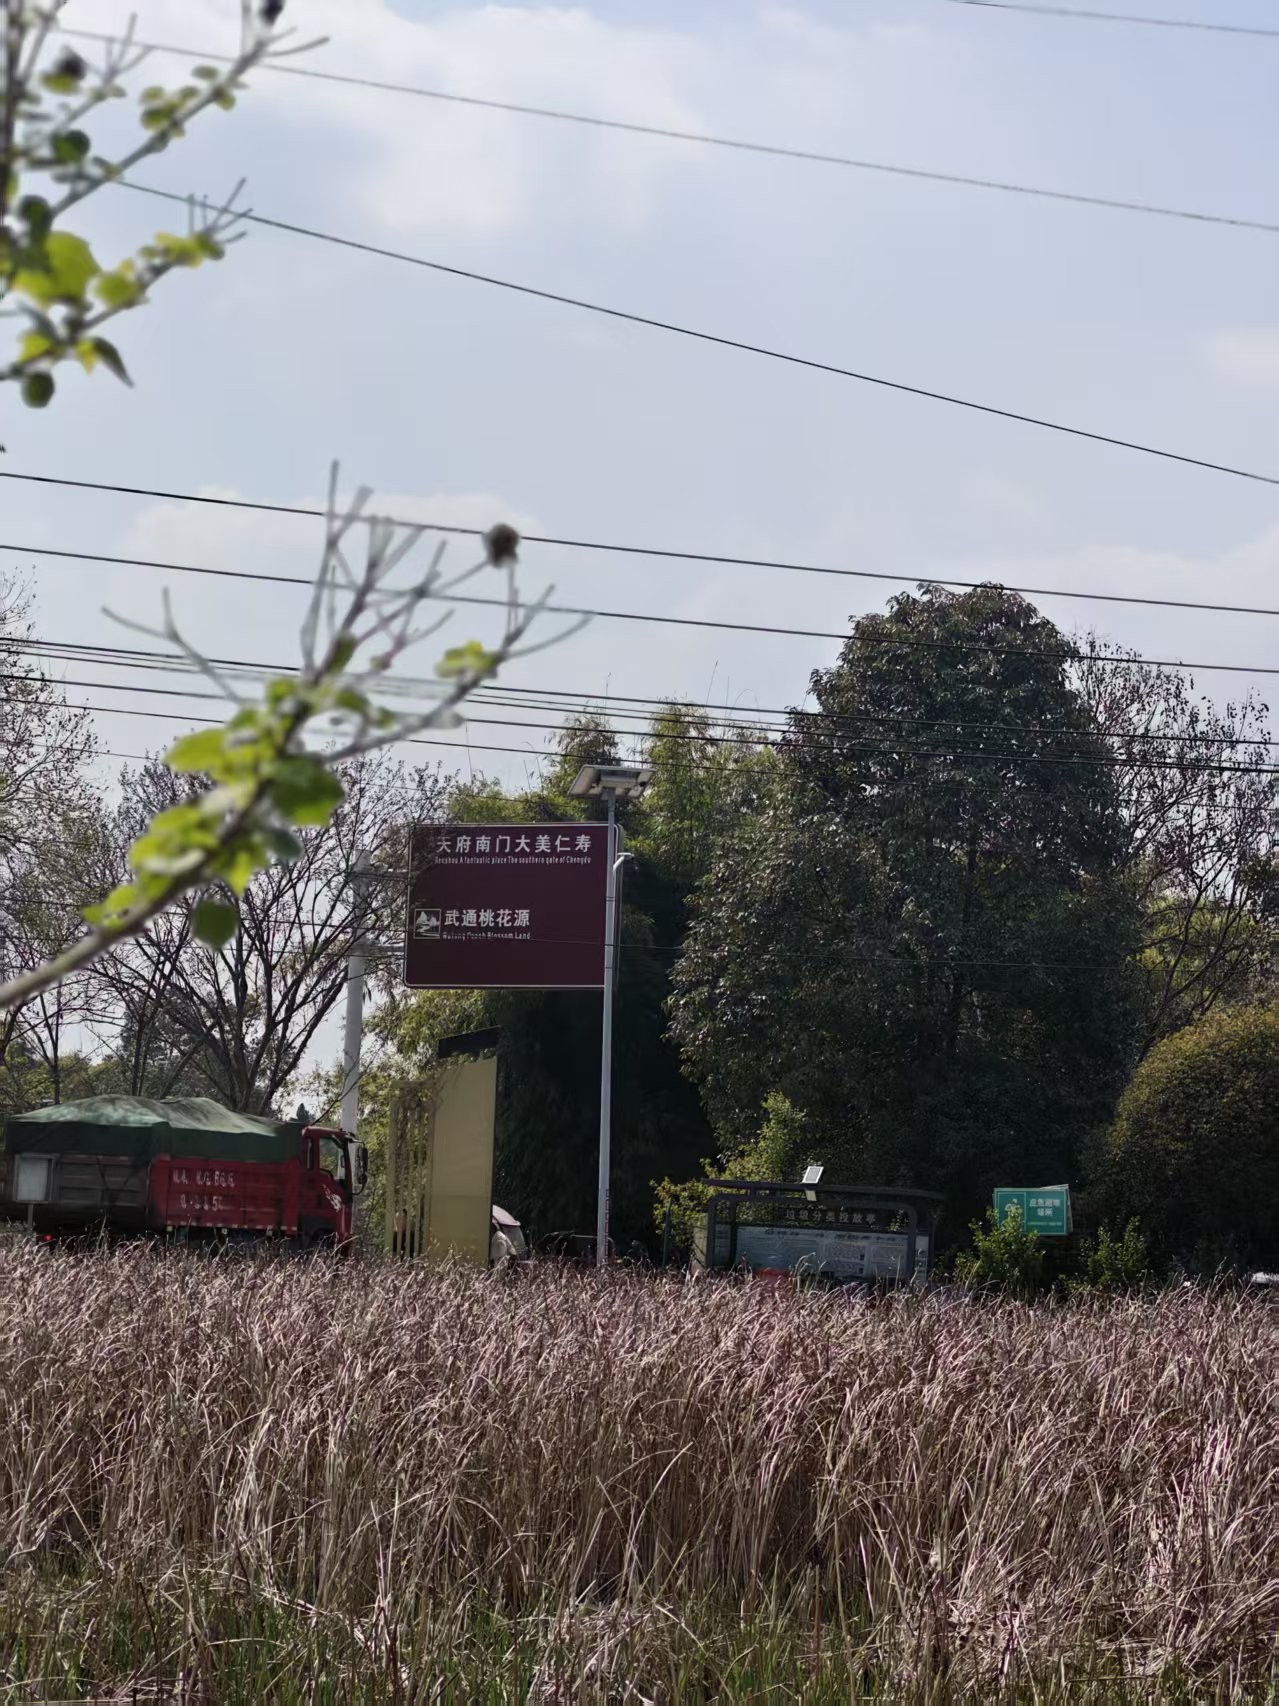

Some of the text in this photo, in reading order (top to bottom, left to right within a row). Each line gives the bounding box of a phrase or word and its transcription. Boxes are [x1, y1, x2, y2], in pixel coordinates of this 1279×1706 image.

[436, 835, 592, 854] 天府南门大美仁寿
[464, 856, 491, 864] fantastic
[491, 856, 507, 865] place
[508, 856, 518, 864] The
[519, 856, 545, 864] southern
[546, 856, 559, 866] gate
[566, 856, 592, 866] Chengdu
[444, 908, 531, 928] 武通桃花源
[514, 932, 531, 940] Land
